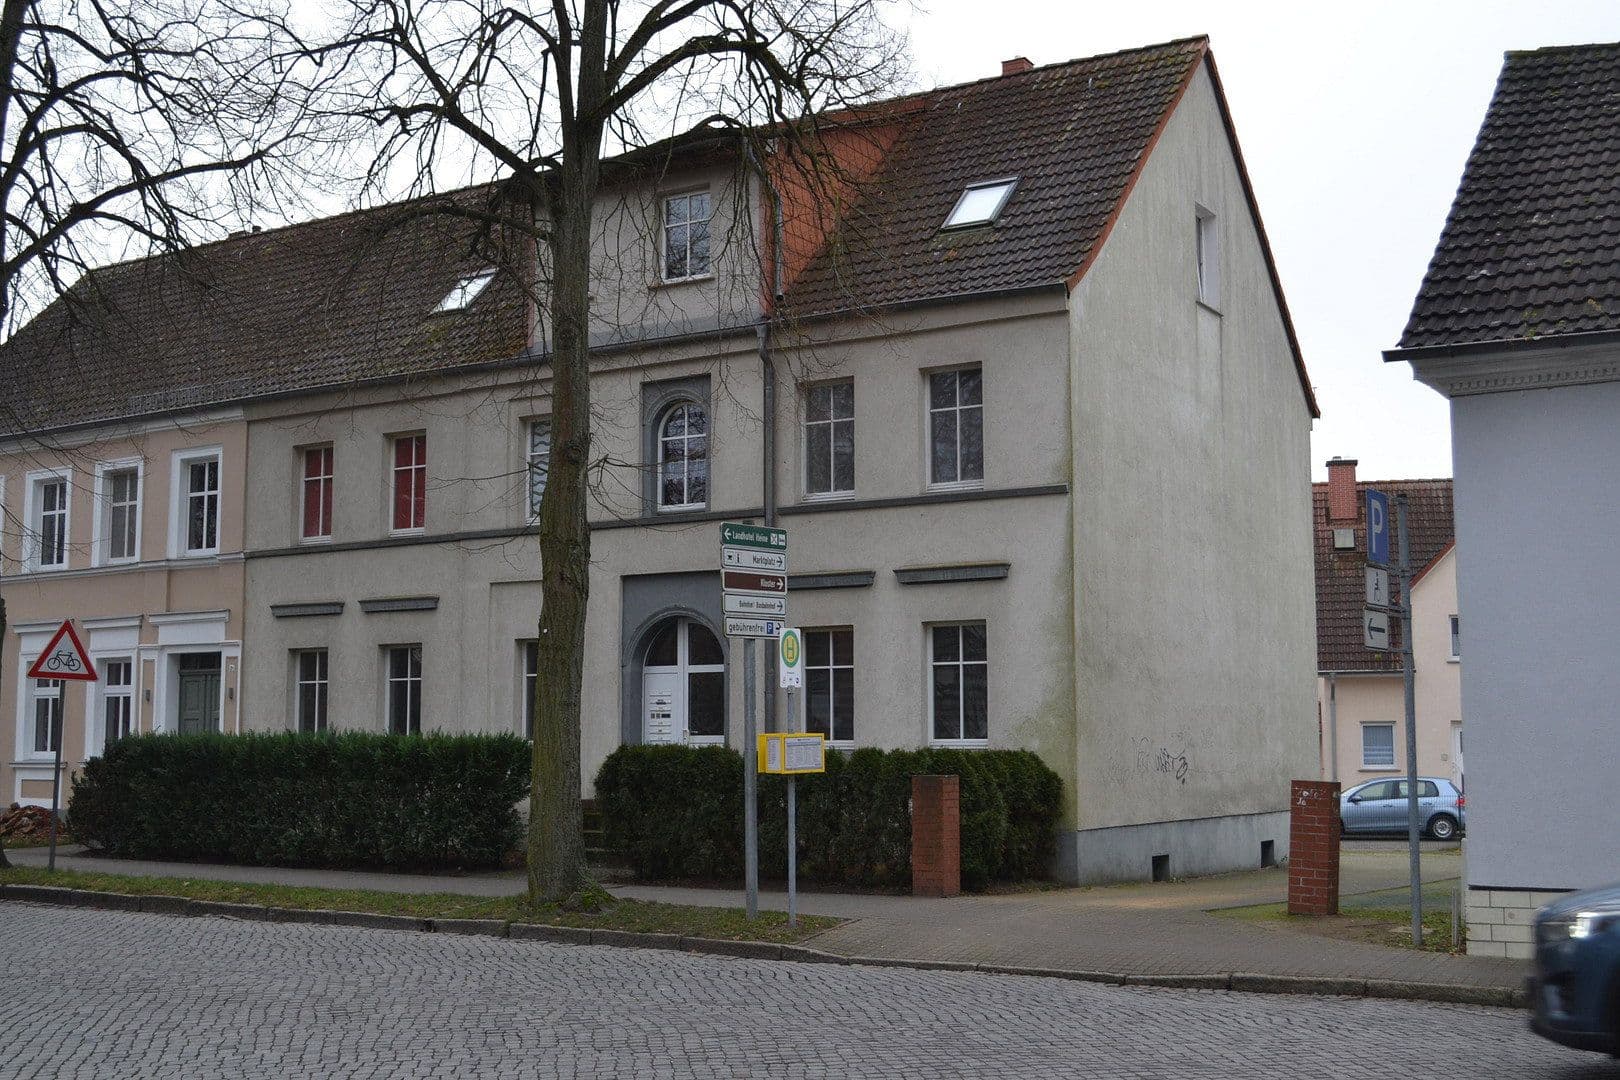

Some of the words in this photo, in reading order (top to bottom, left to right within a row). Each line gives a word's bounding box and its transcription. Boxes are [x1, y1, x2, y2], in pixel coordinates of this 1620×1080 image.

[1371, 498, 1383, 554] P
[753, 554, 776, 566] Marktplatz
[728, 622, 765, 633] gebührenfrei
[768, 623, 773, 633] P
[787, 638, 794, 659] H
